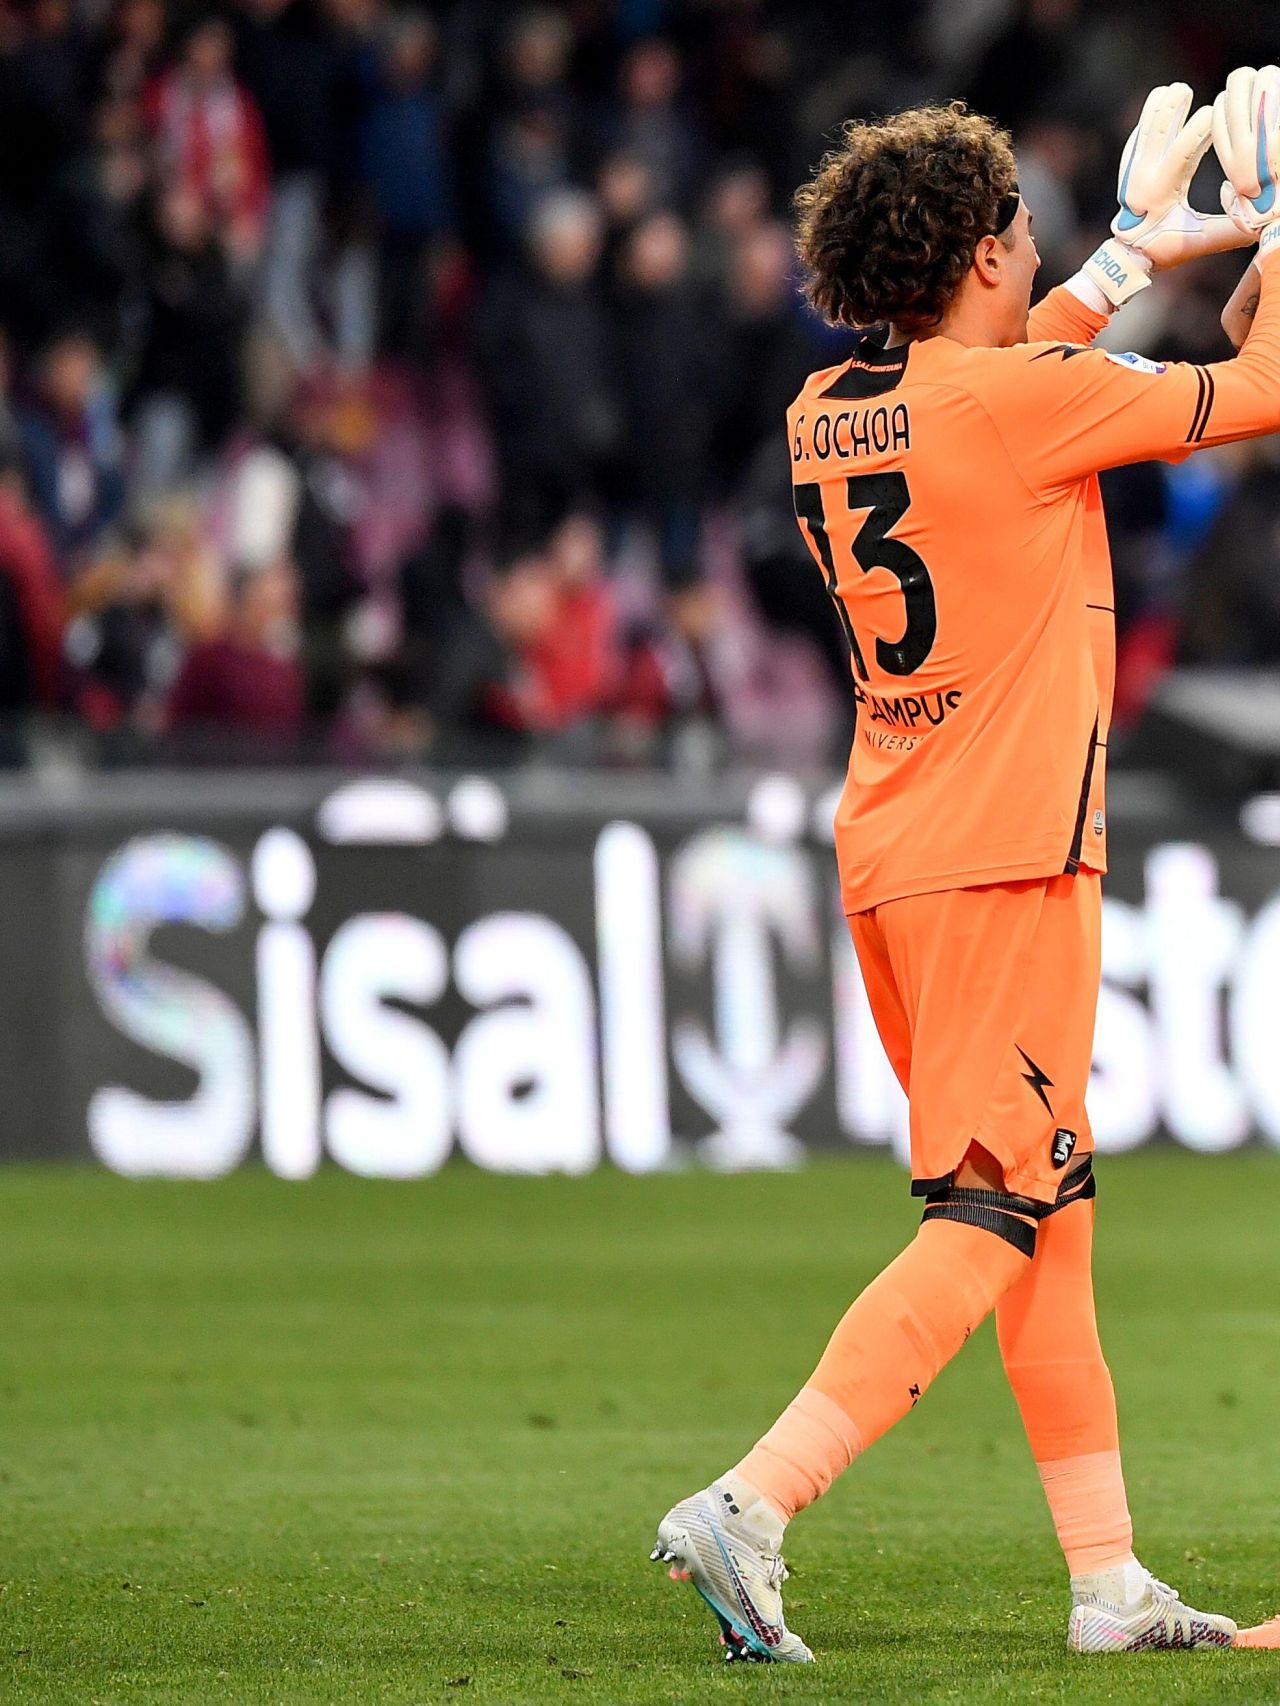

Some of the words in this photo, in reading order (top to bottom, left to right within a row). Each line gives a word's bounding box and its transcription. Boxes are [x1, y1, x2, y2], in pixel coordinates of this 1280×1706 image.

[793, 403, 910, 462] G.OCHOA
[794, 471, 937, 682] 13
[85, 828, 668, 1180] Sisal
